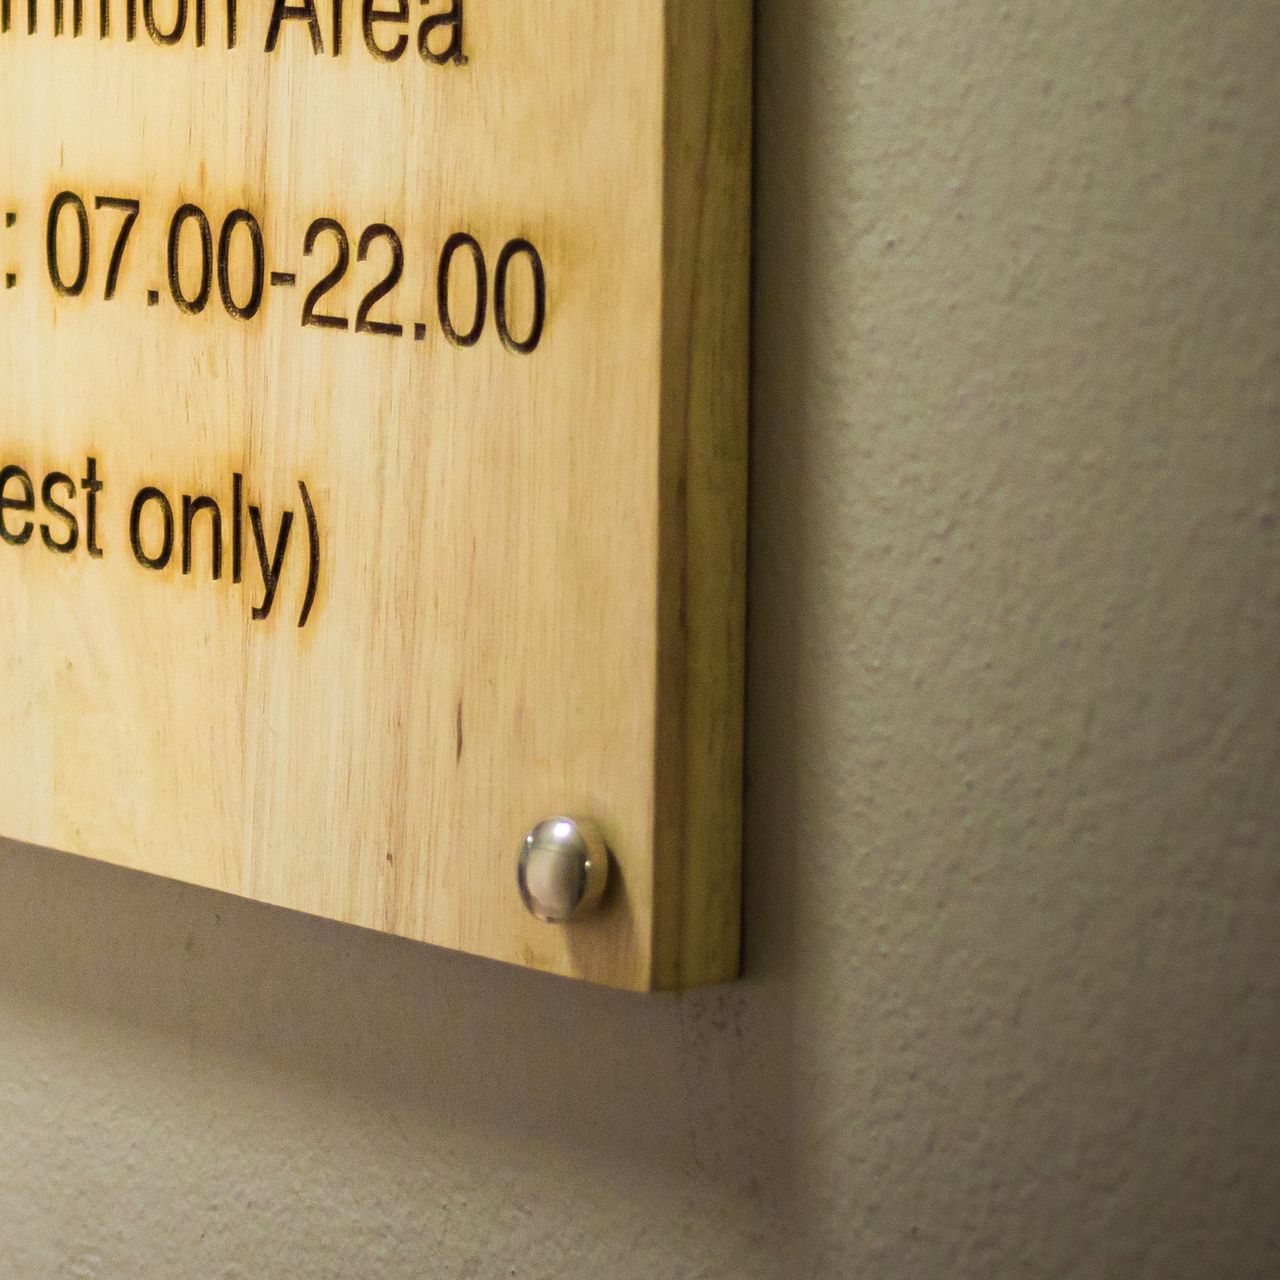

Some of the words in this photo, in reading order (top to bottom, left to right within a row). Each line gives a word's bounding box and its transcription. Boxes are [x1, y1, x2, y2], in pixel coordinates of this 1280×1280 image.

[4, 212, 19, 289] :
[45, 190, 548, 356] 07.00-22.00
[130, 473, 321, 629] only)
